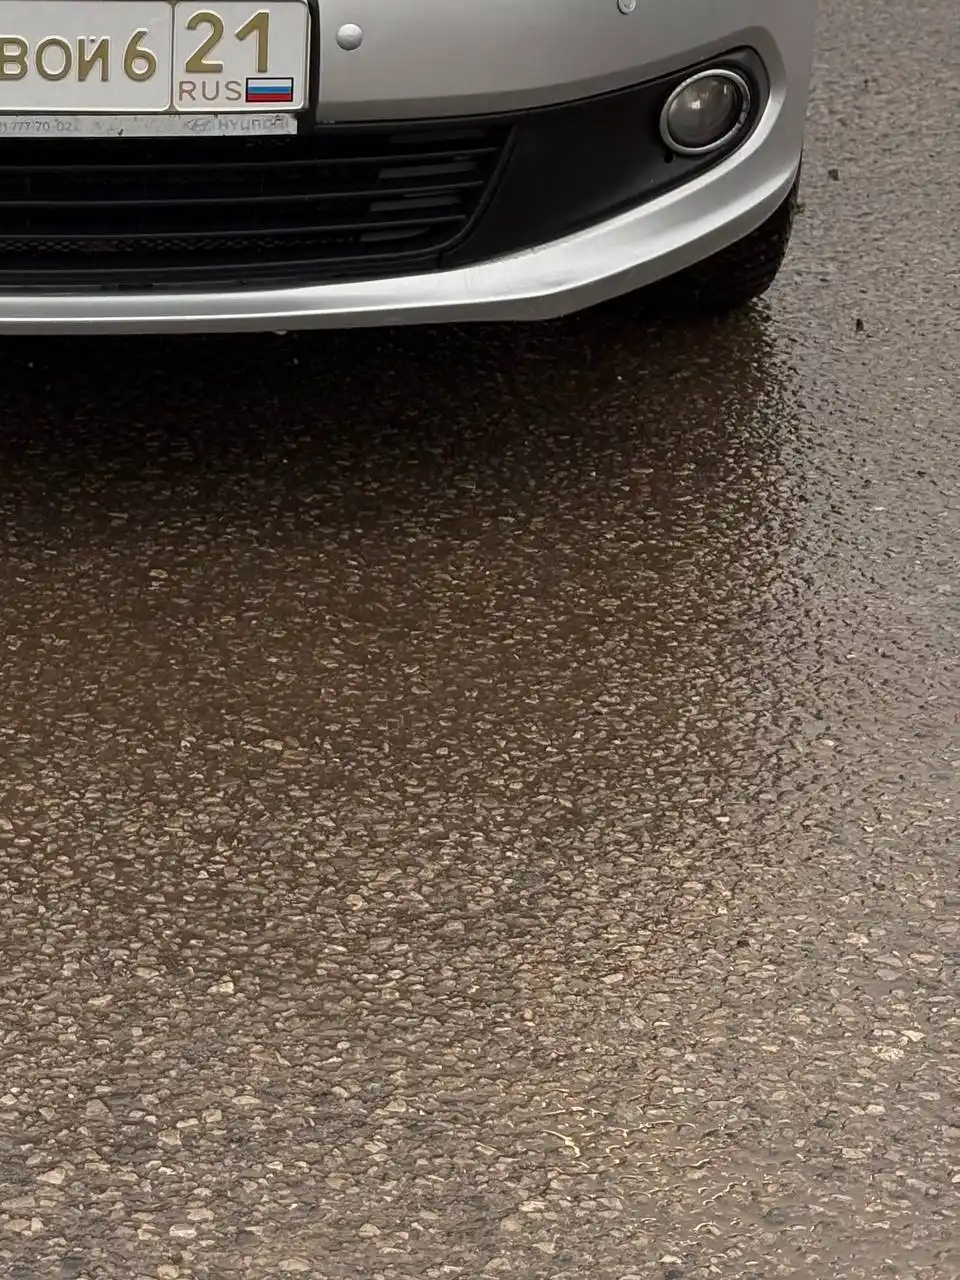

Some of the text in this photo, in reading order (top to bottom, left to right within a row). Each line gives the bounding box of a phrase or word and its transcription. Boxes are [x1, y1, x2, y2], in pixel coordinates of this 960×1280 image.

[123, 27, 159, 83] 6
[184, 9, 271, 74] 21
[177, 80, 243, 103] RUS
